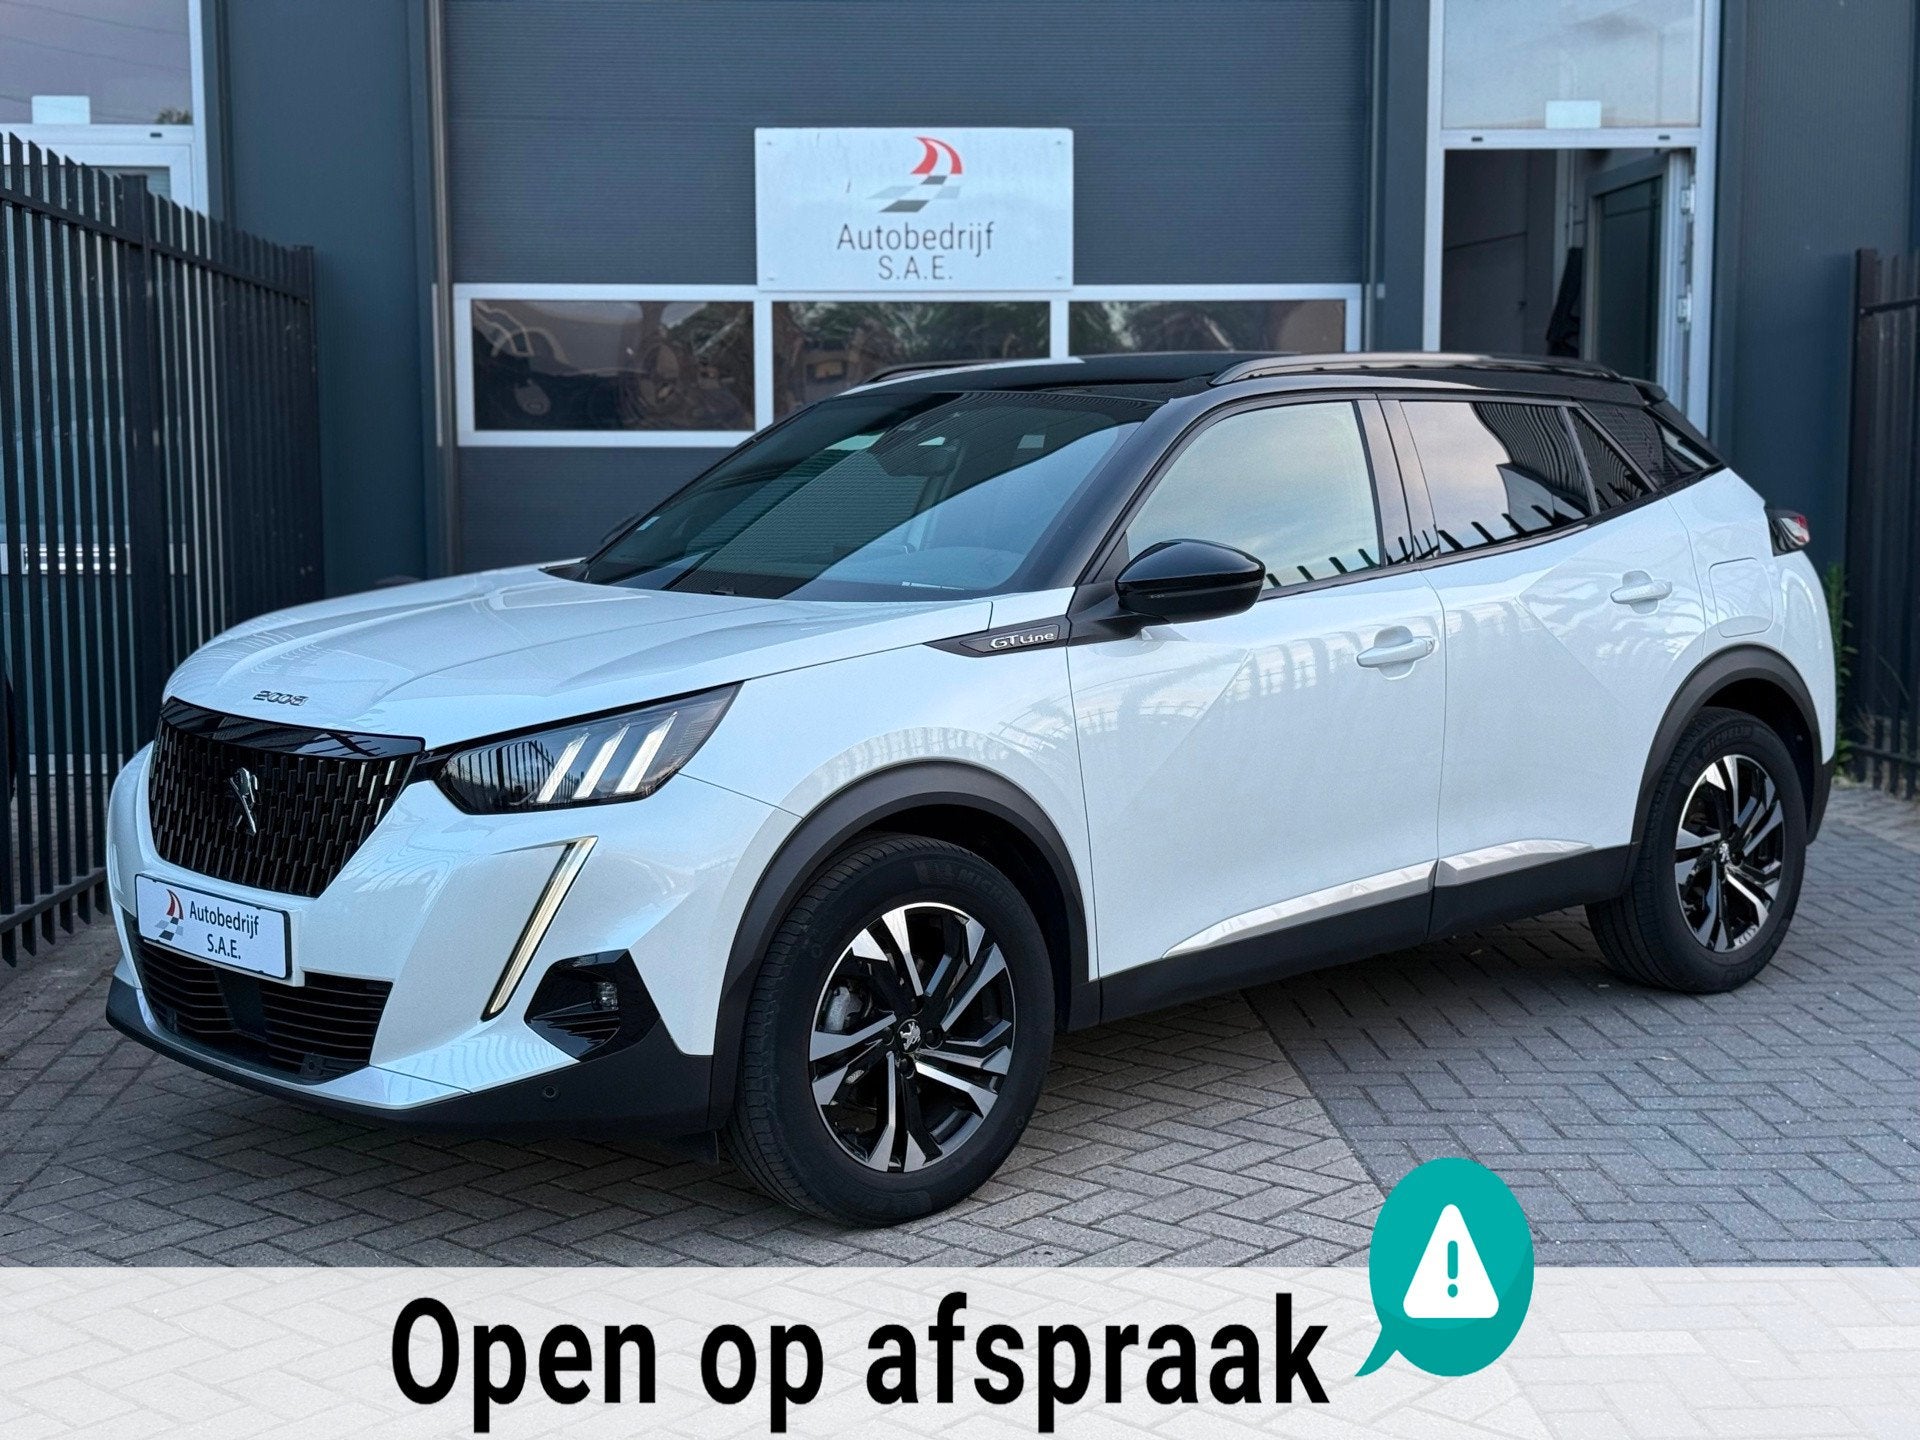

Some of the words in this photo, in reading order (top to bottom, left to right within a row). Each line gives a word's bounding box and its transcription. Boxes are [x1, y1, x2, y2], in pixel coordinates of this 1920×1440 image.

[836, 221, 995, 258] Autobedrijf
[878, 255, 953, 280] S.A.E.
[252, 690, 309, 707] 2008
[189, 901, 260, 940] Autobedrijf
[207, 933, 242, 960] S.A.E.
